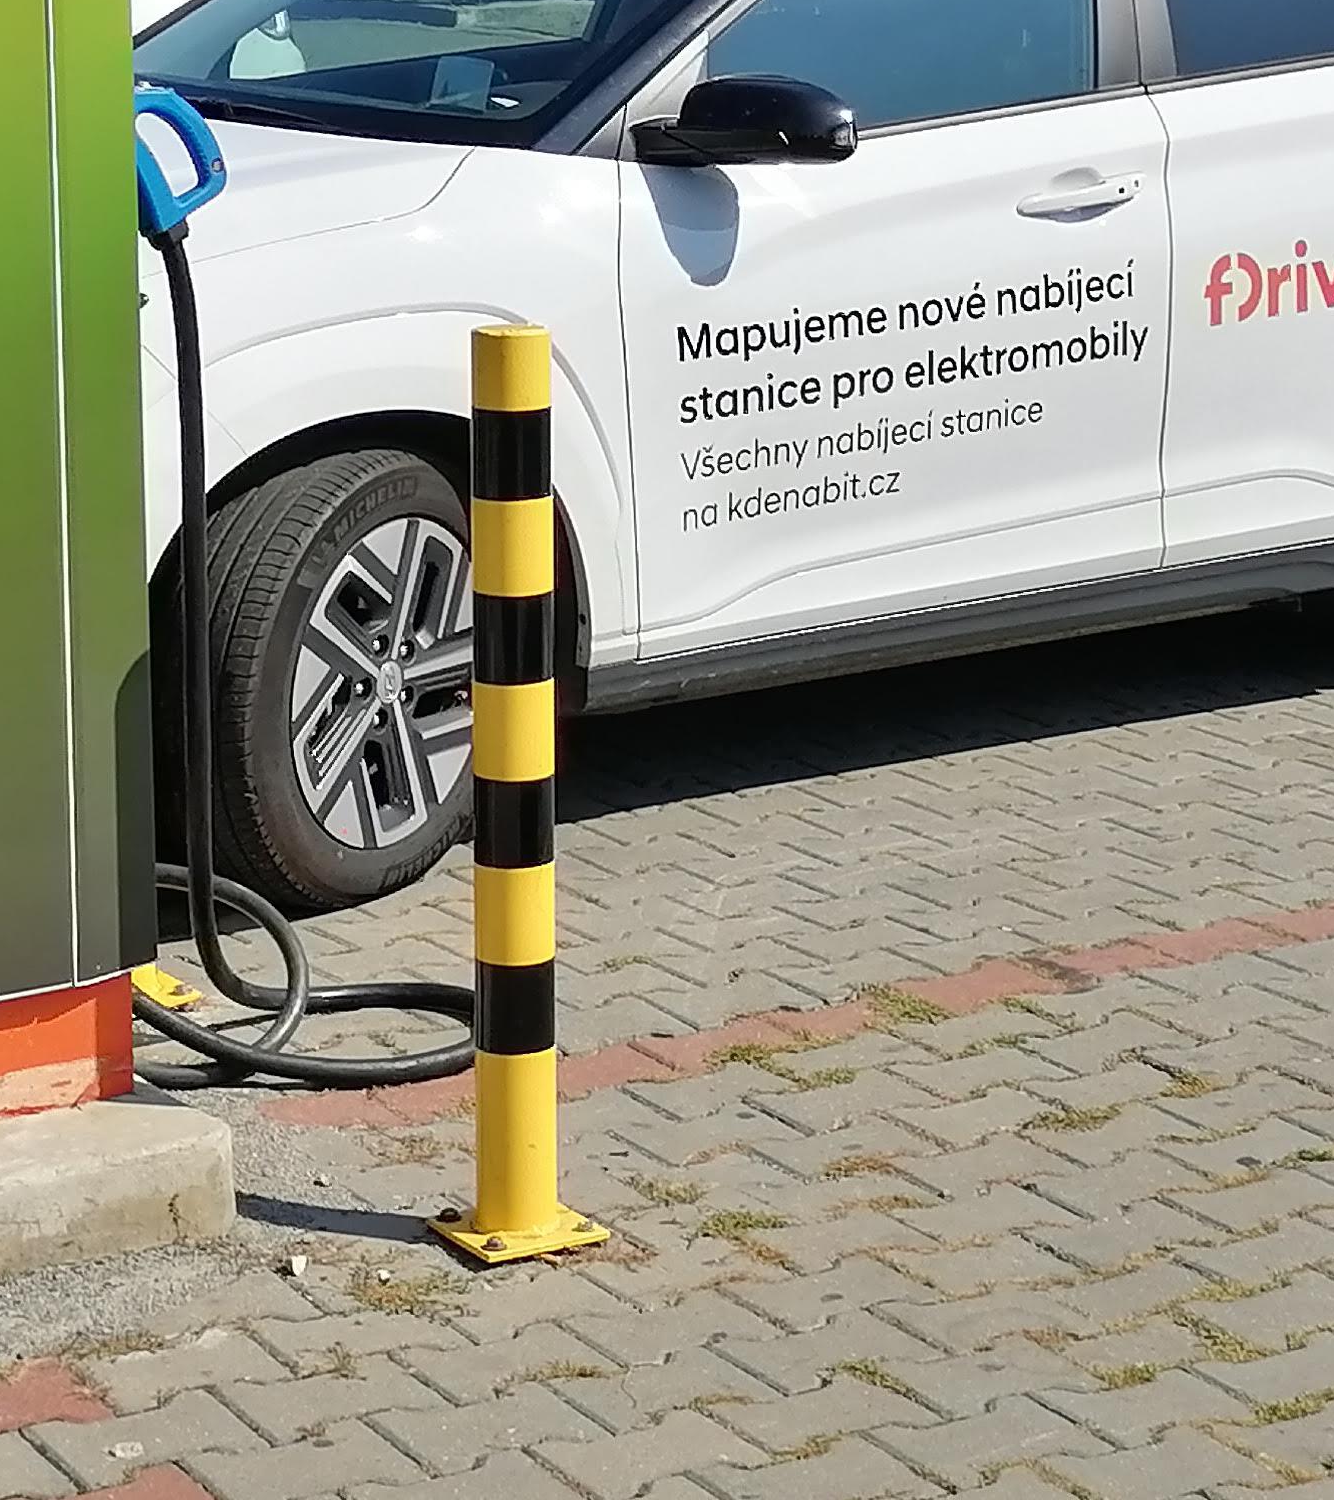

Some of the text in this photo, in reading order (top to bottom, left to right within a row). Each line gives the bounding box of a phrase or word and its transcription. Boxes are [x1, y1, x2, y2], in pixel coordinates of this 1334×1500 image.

[677, 258, 1134, 362] Mapujeme nové nabíjecí
[680, 320, 1149, 424] stanice pro elektromobily
[680, 399, 1044, 480] Všechny nabíjecí stanice
[682, 470, 901, 532] na kdenabit.cz
